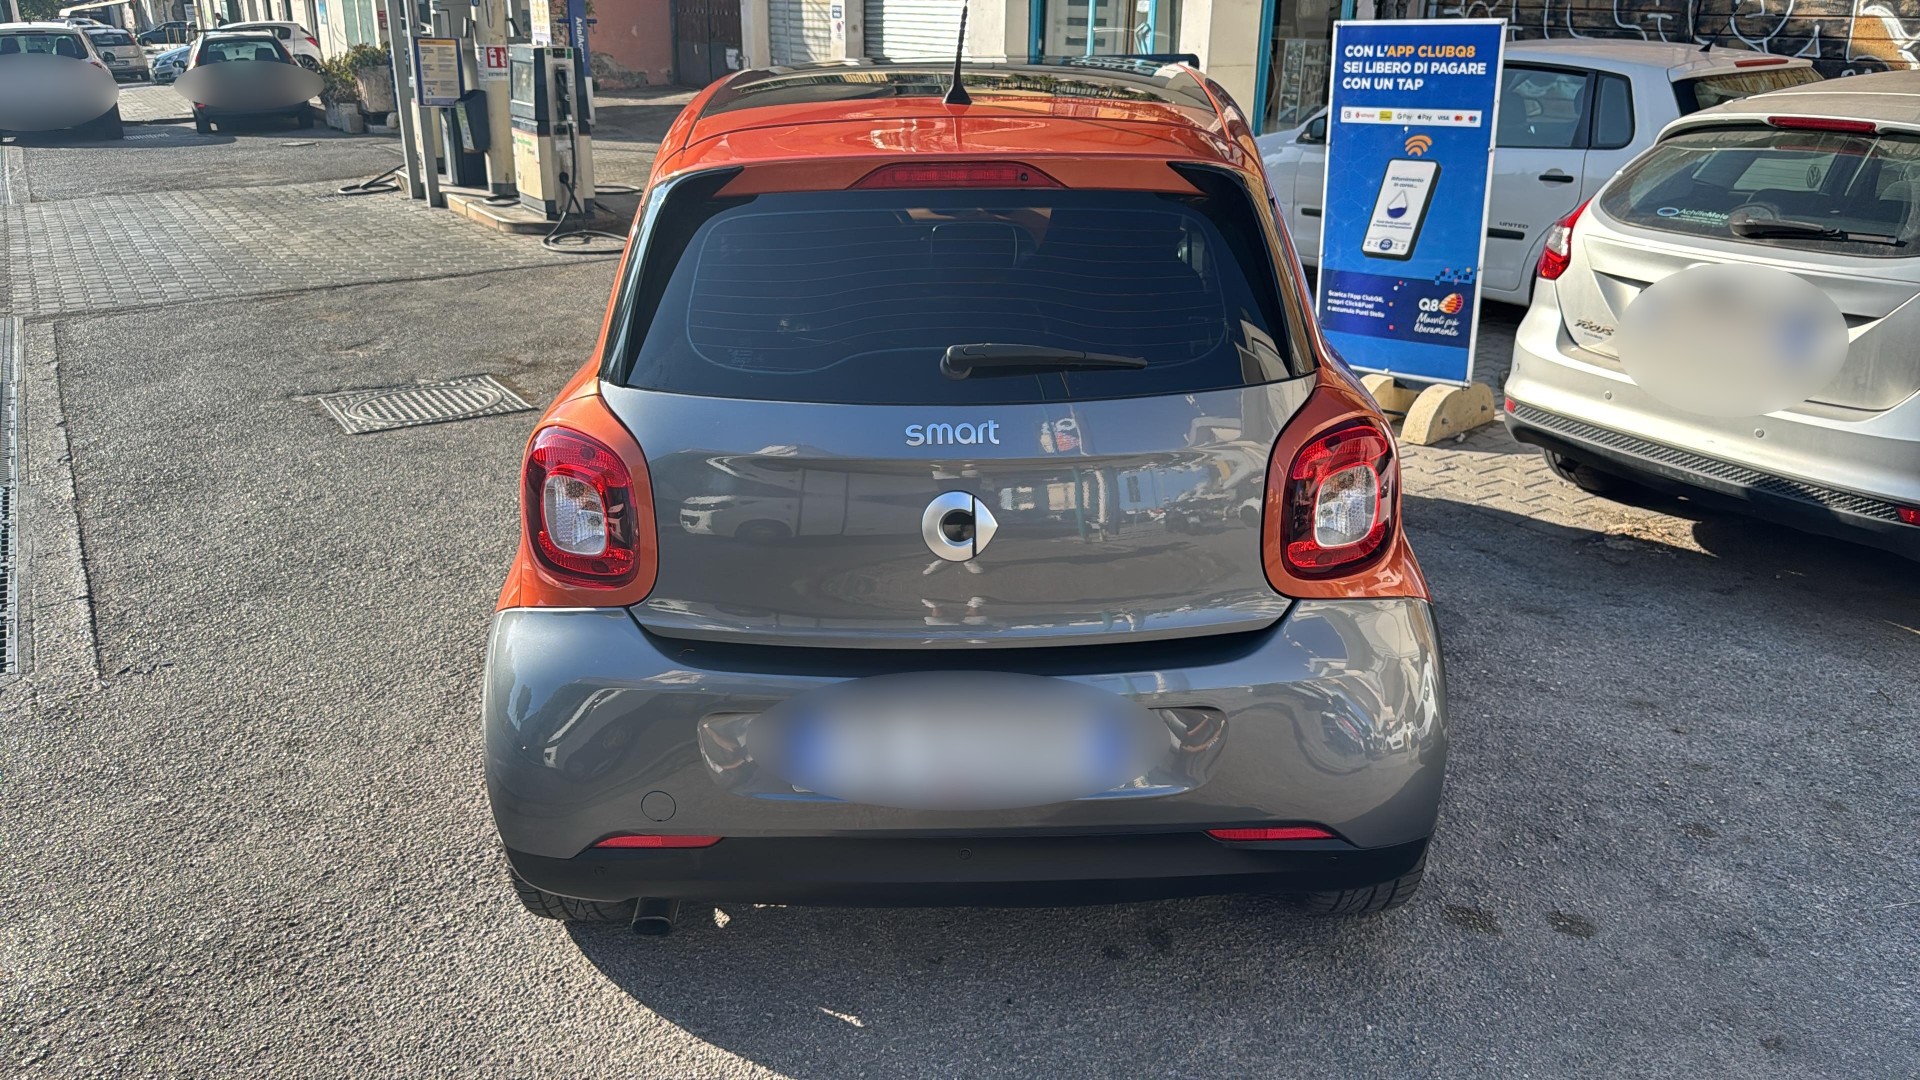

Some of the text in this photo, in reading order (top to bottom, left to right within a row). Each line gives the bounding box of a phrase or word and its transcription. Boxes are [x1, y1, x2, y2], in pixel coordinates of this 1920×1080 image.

[1344, 45, 1476, 59] CON L'APP CLUBQ8
[1343, 61, 1487, 75] SEI LIBERO DI PAGARE
[1342, 77, 1424, 91] CON UN TAP
[1499, 221, 1529, 229] UNITED
[1328, 289, 1347, 299] Scarica
[1328, 298, 1345, 306] scopri
[1418, 297, 1439, 312] Q8
[1355, 307, 1369, 316] Punti
[1369, 309, 1386, 319] Stella
[1413, 322, 1459, 337] liberamente
[905, 419, 1000, 446] smart
